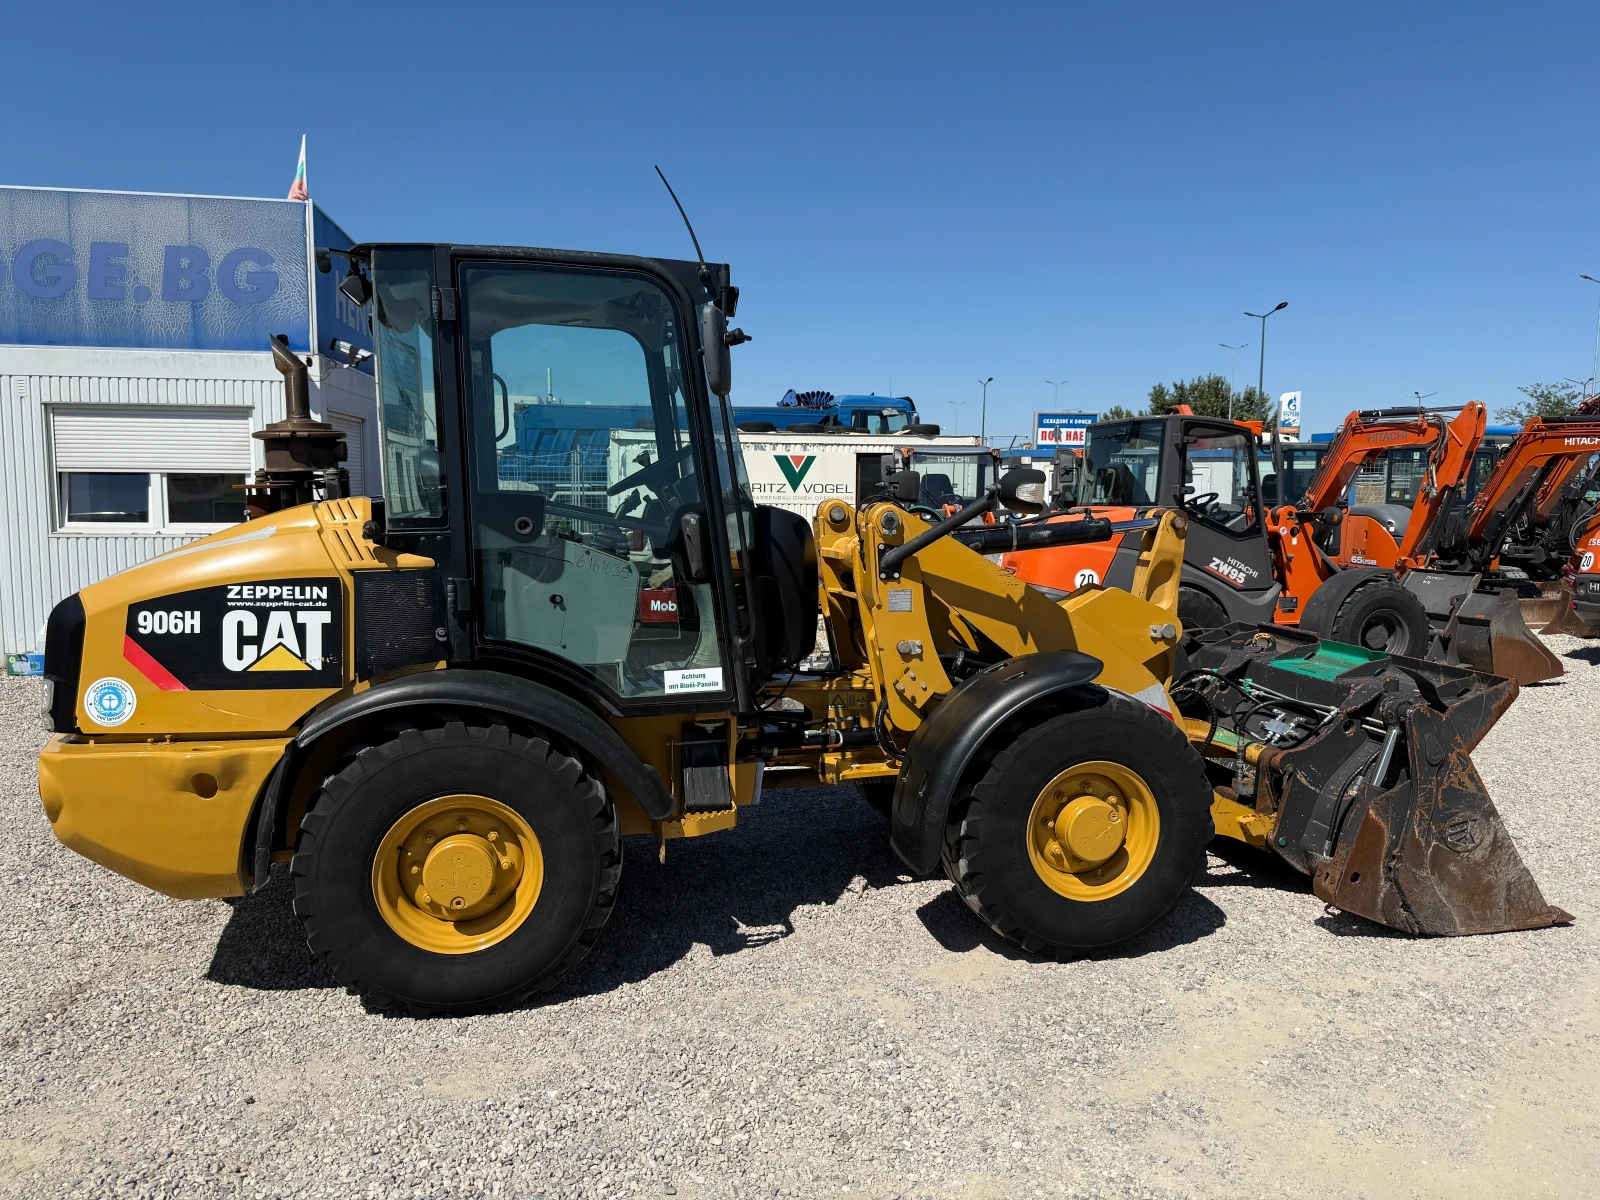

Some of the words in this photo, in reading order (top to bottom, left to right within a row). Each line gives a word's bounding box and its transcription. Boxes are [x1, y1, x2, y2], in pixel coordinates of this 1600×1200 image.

[0, 238, 279, 305] GE.BG
[1367, 431, 1409, 443] HITACHI
[1564, 436, 1600, 446] HITACH
[802, 483, 853, 494] VOGEL
[1226, 556, 1259, 579] HITACHI
[1581, 555, 1592, 567] 20
[1208, 556, 1247, 584] ZW95
[1079, 573, 1094, 588] 20
[226, 585, 328, 600] ZEPPELIN
[137, 610, 200, 635] 906H
[222, 609, 332, 672] CAT
[681, 673, 706, 681] Achtung
